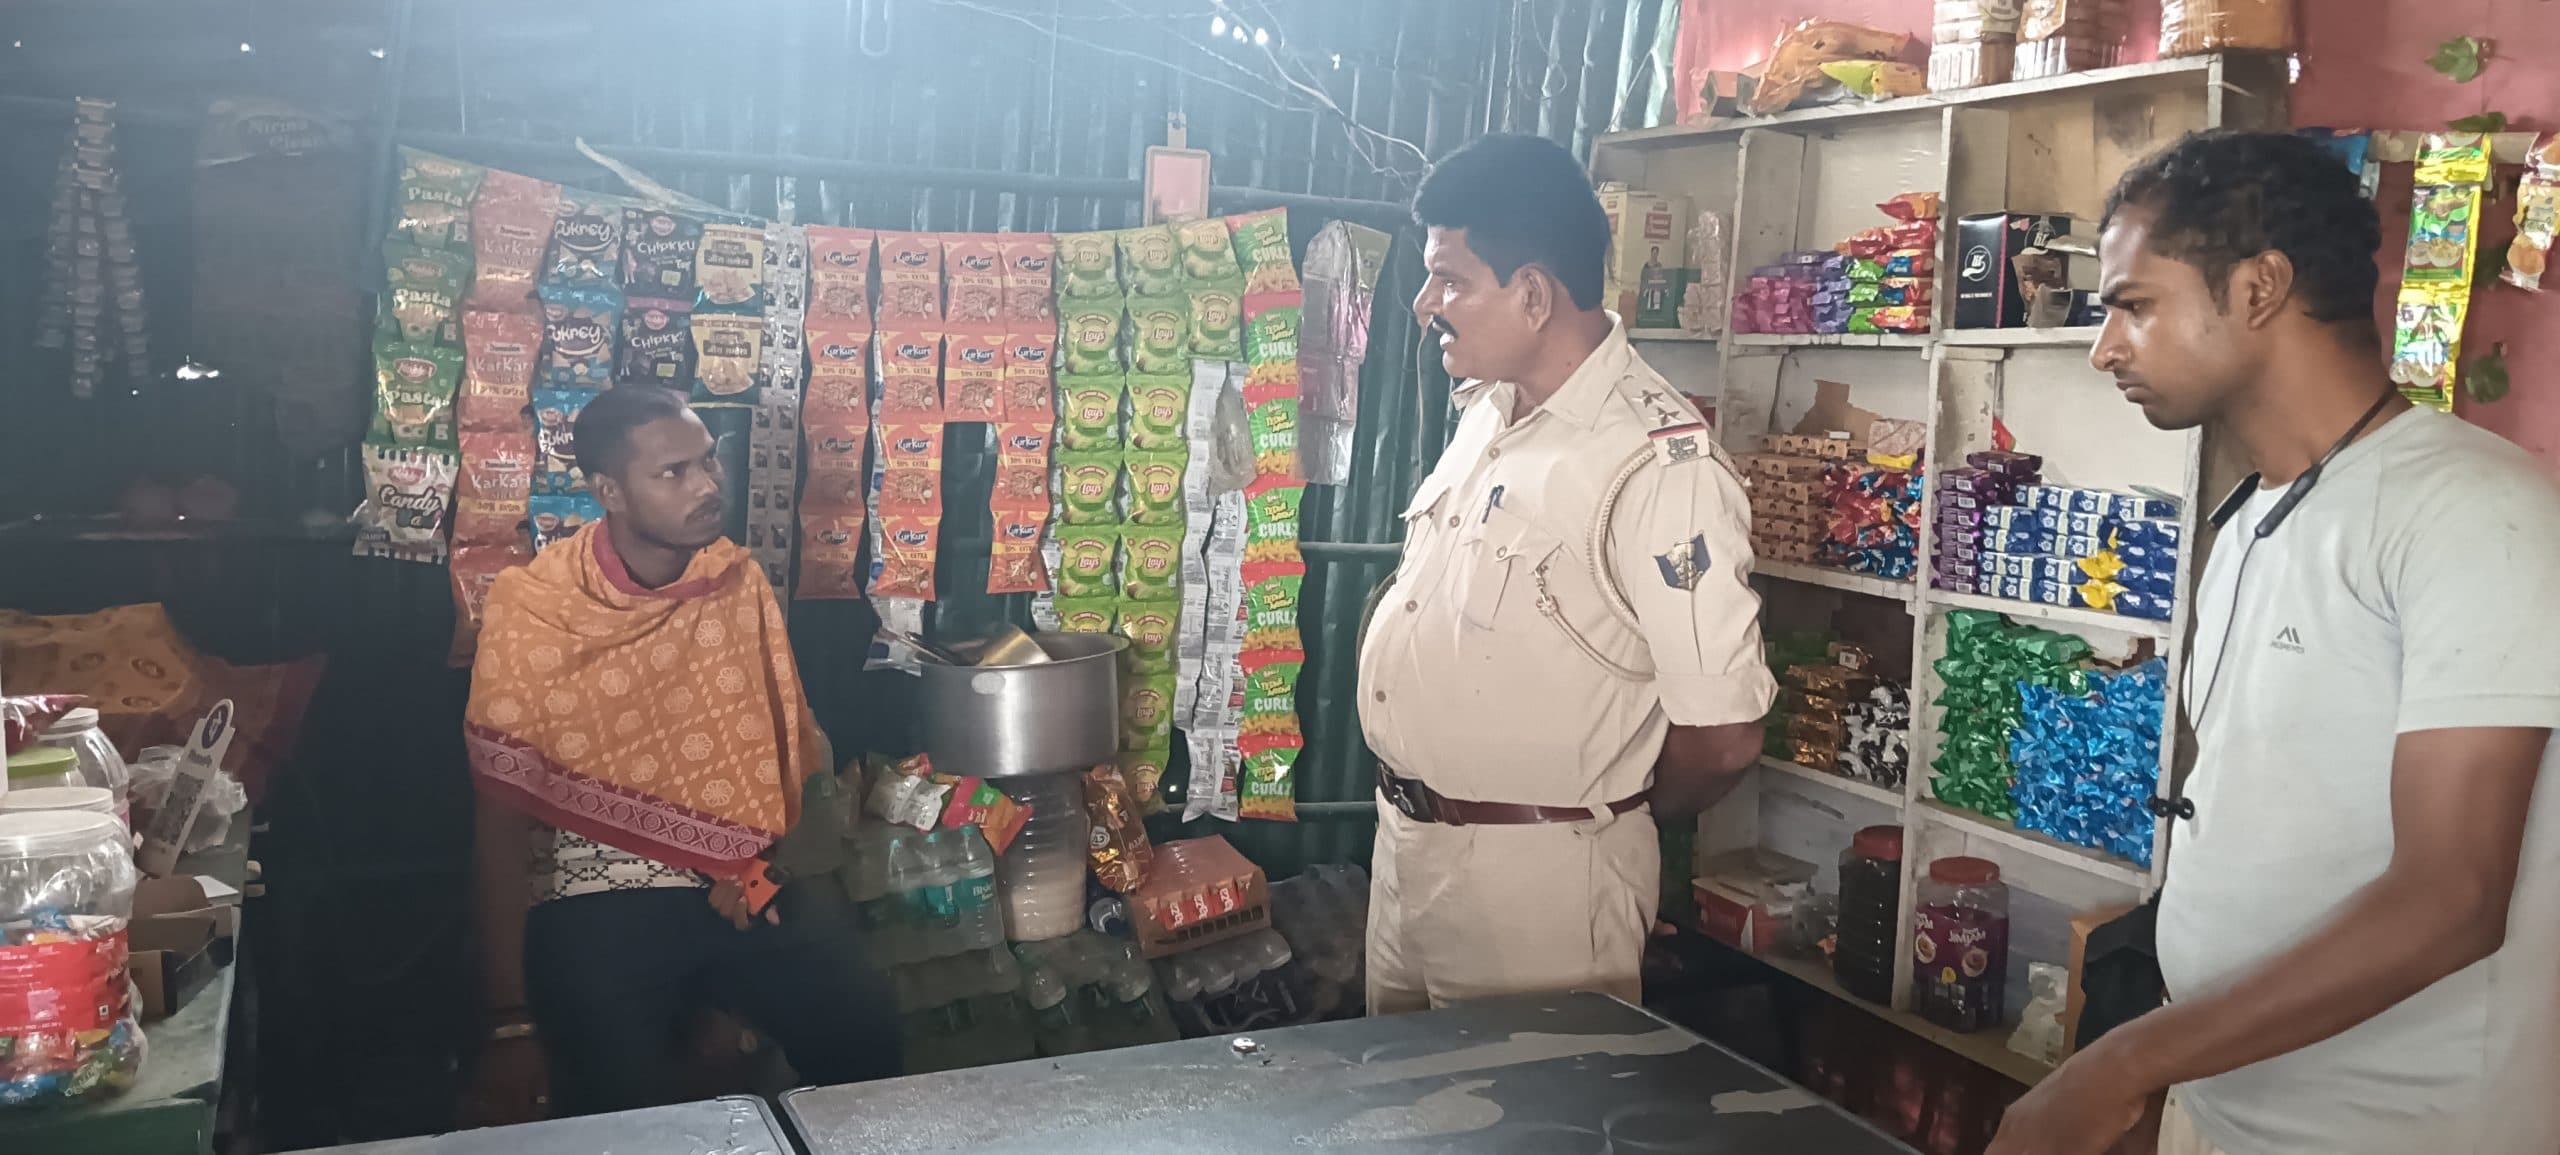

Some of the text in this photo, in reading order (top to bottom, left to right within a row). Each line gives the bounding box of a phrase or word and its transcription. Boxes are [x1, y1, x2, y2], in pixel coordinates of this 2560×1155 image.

[408, 187, 463, 207] Pasta
[394, 288, 450, 308] Pasta
[381, 484, 440, 516] Candy
[1256, 611, 1297, 626] CURLZ
